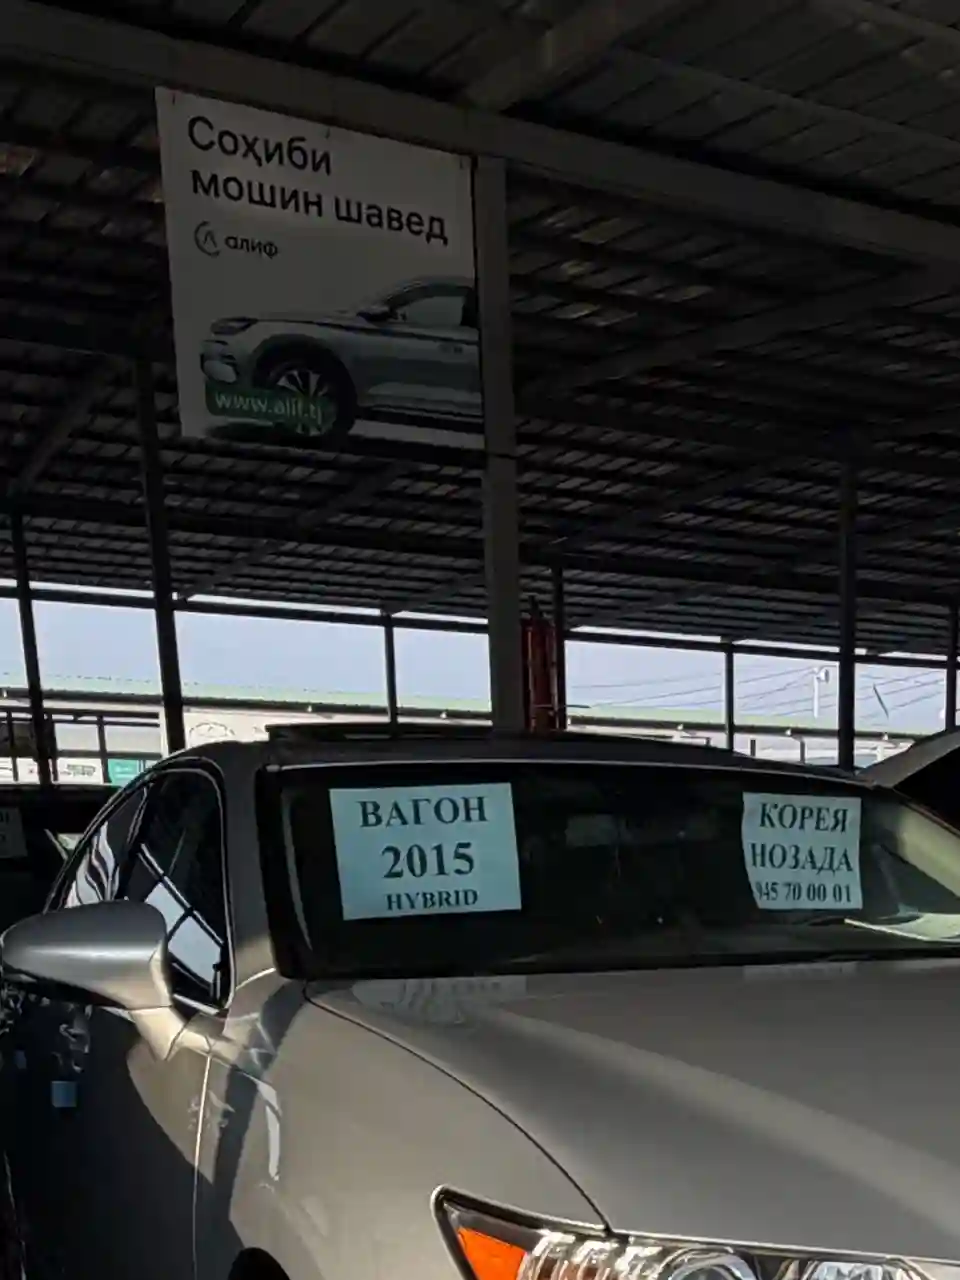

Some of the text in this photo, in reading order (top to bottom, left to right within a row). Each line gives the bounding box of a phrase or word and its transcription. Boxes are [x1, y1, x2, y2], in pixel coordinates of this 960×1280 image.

[188, 115, 332, 177] Соҳиби
[191, 169, 449, 246] мошин шавед
[224, 235, 279, 260] алиф
[358, 796, 489, 828] ВАГОН
[759, 802, 848, 833] КОРЕЯ
[381, 841, 475, 879] 2015
[750, 842, 853, 876] НОЗАДА
[386, 889, 479, 911] HYBRID
[782, 882, 802, 901] 70
[807, 883, 827, 902] 00
[833, 883, 851, 903] 01
